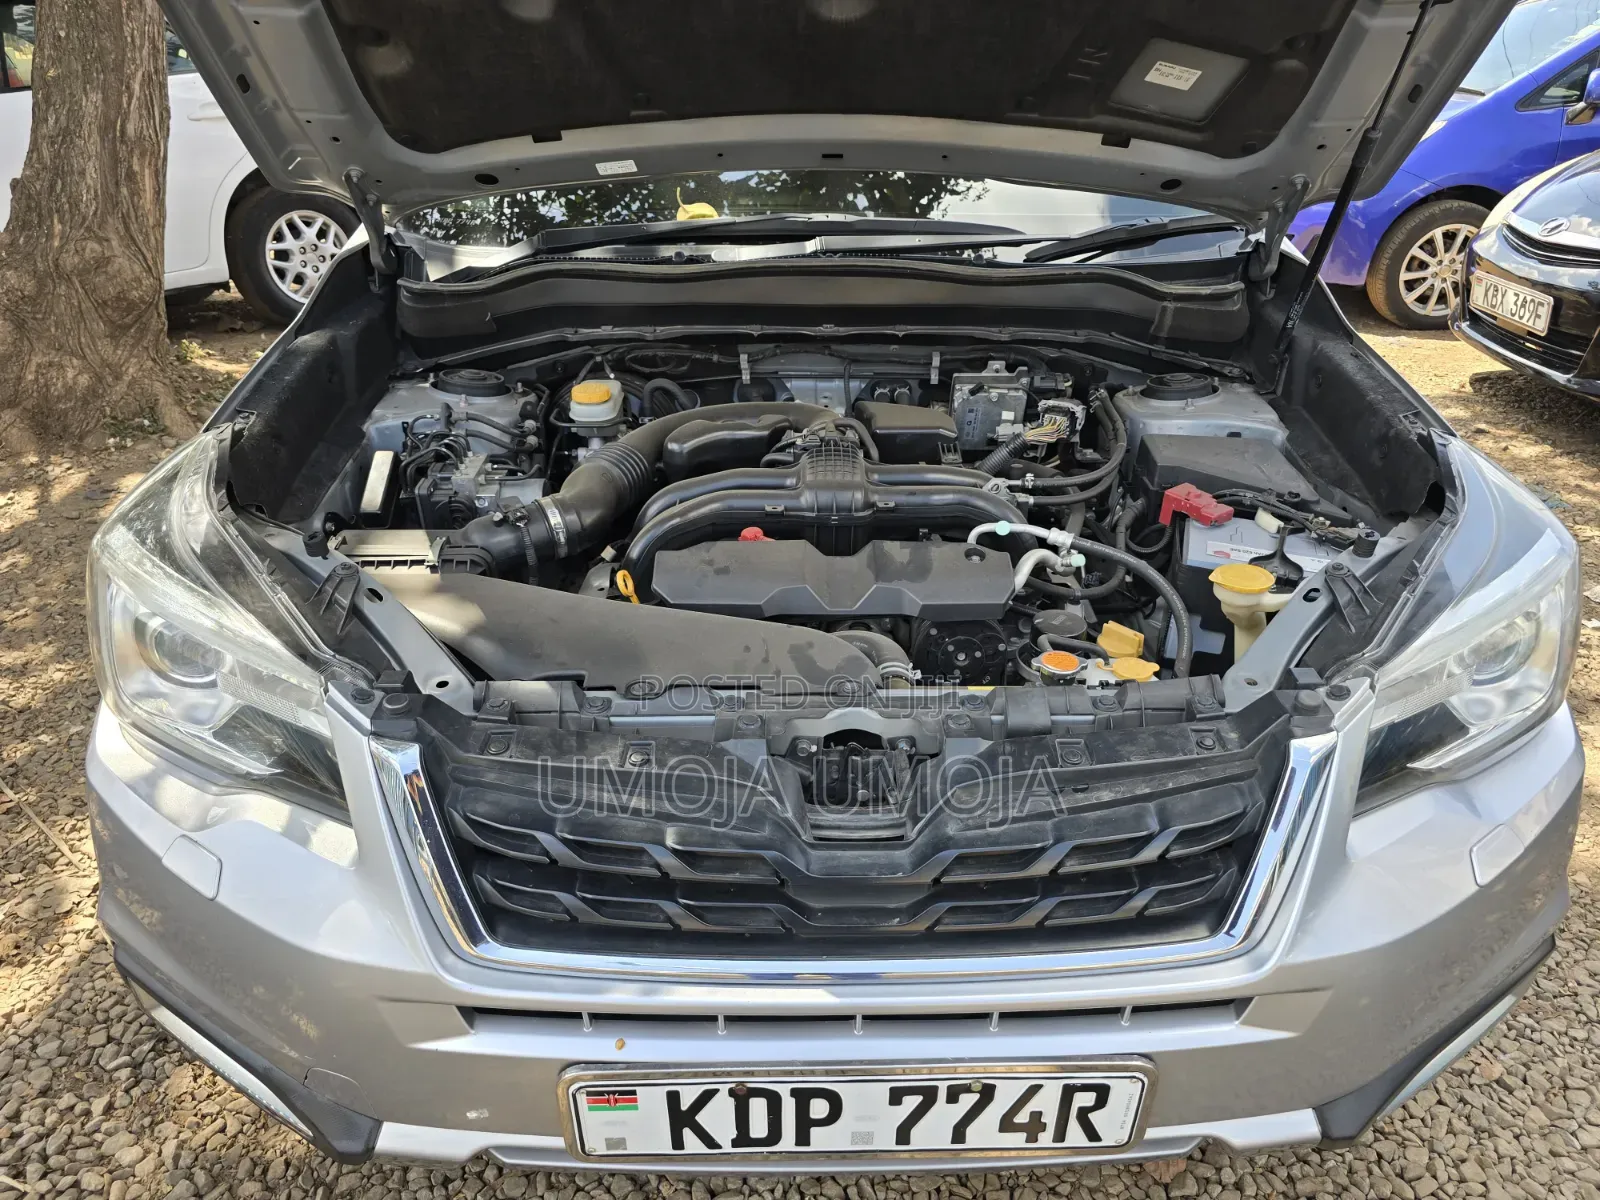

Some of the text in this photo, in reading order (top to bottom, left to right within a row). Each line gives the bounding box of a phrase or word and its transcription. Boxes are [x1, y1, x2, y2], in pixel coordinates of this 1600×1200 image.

[1482, 281, 1507, 313] KBX
[665, 1083, 1111, 1150] KDP 774R
